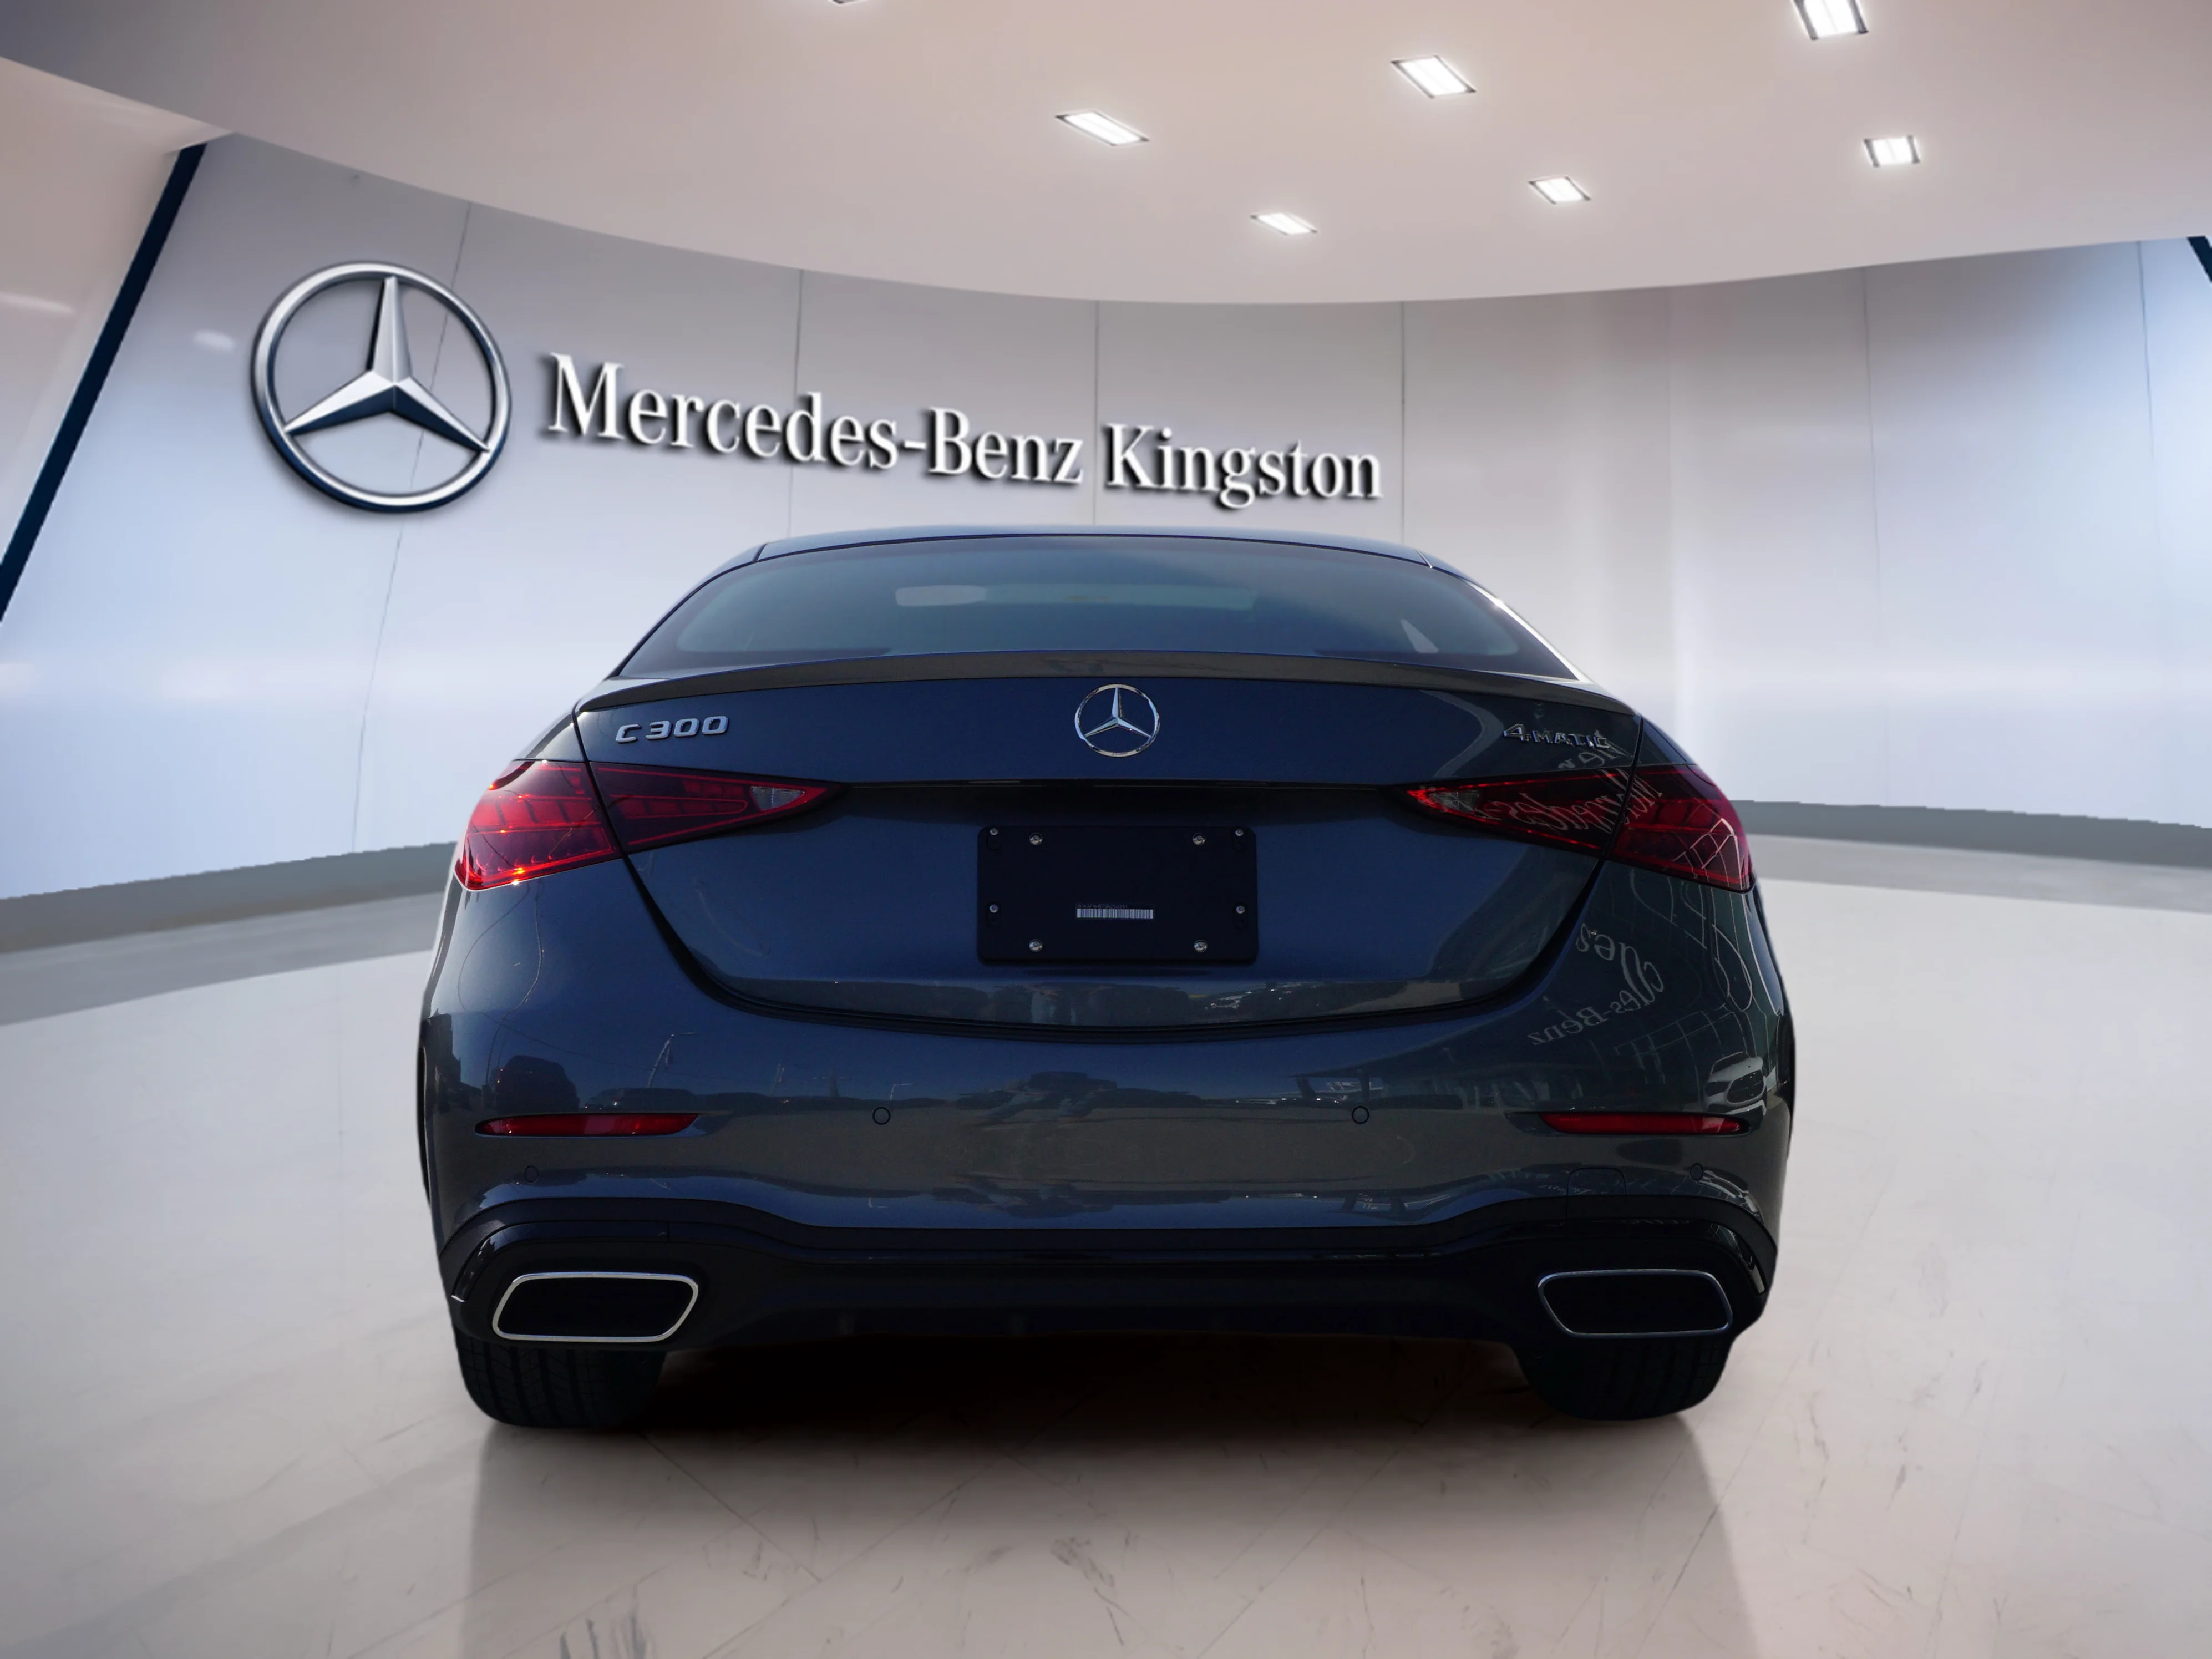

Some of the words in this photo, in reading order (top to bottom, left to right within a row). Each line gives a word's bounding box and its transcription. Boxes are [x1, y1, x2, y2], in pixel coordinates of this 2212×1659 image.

[549, 352, 1084, 484] Mercedes-Benz
[1105, 423, 1383, 508] Kingston
[615, 724, 641, 743] C
[645, 716, 729, 740] 300
[1503, 723, 1610, 748] 4MATIC
